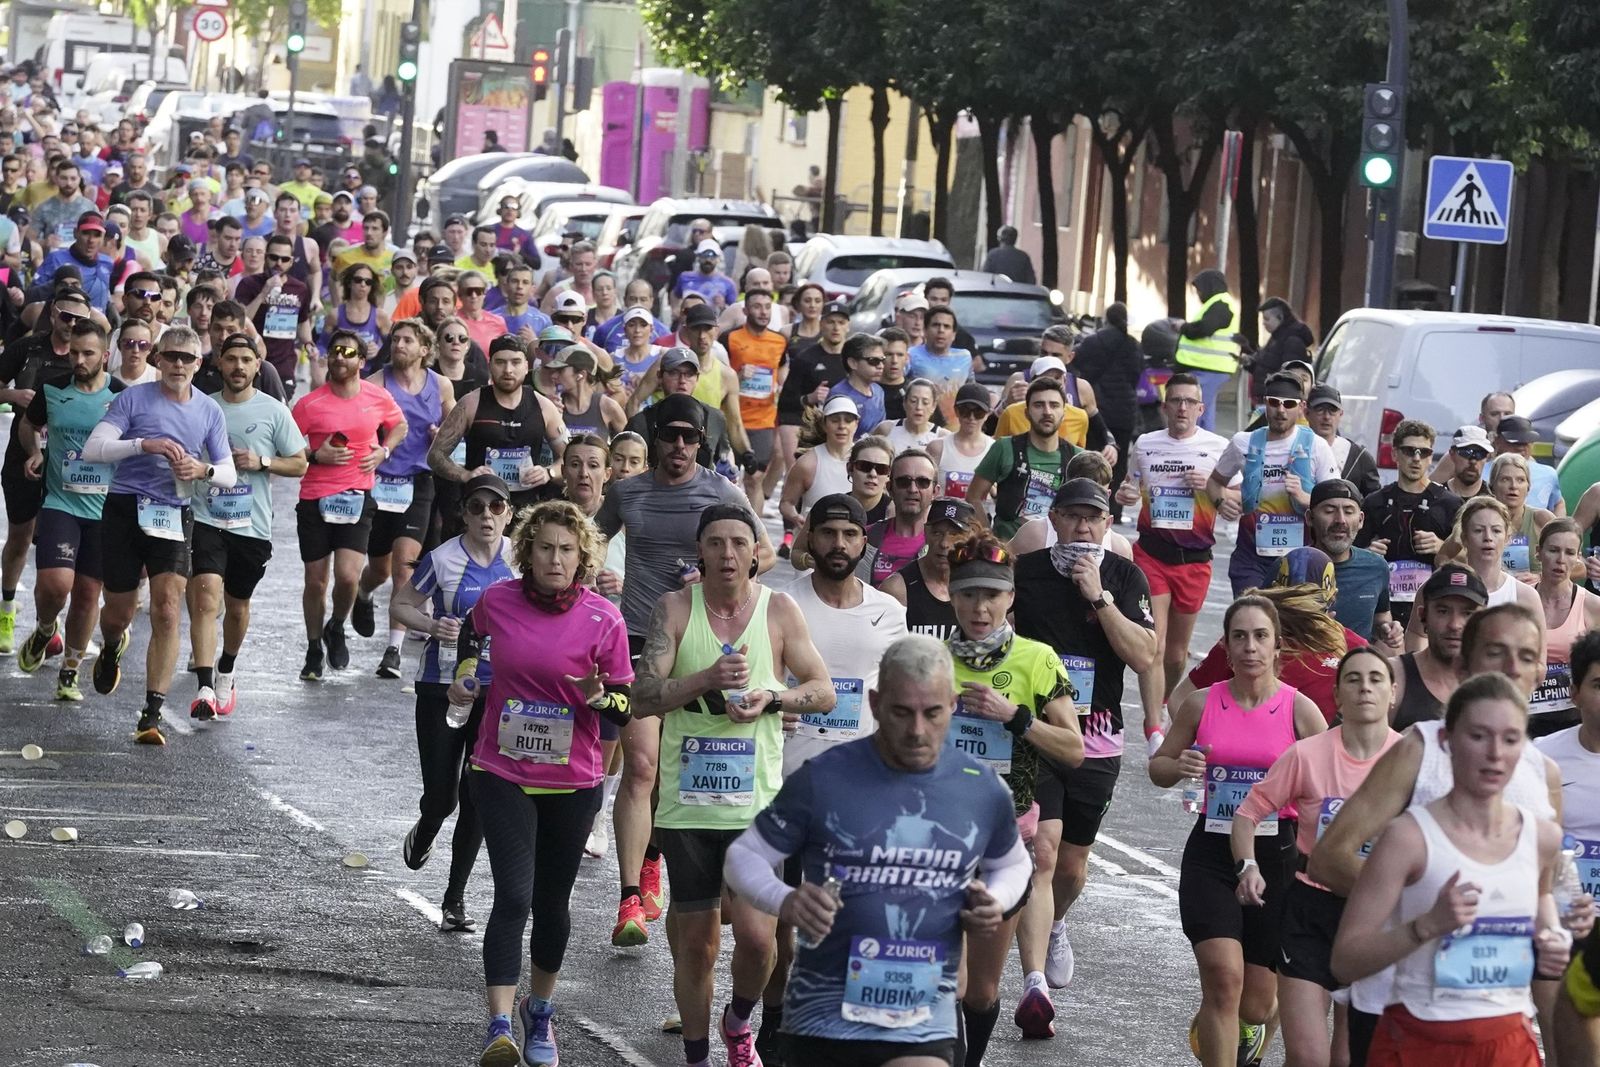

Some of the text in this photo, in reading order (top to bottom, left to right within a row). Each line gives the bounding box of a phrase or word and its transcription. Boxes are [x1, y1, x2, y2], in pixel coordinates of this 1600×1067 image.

[200, 18, 221, 30] 30
[70, 473, 101, 484] GARRO
[325, 503, 354, 514] MICHEL
[1152, 509, 1190, 519] LAURENT
[1271, 536, 1288, 546] ELS
[812, 717, 859, 727] AL-MUTAIRI
[523, 723, 549, 734] 14762
[961, 725, 984, 737] 8645
[516, 735, 552, 751] RUTH
[704, 742, 746, 751] ZURICH
[955, 739, 987, 755] FITO
[705, 762, 727, 771] 7789
[692, 775, 741, 789] XAVITO
[1217, 803, 1240, 818] AN
[871, 845, 963, 870] MEDIA
[885, 944, 937, 959] ZURICH
[884, 971, 914, 984] 9358
